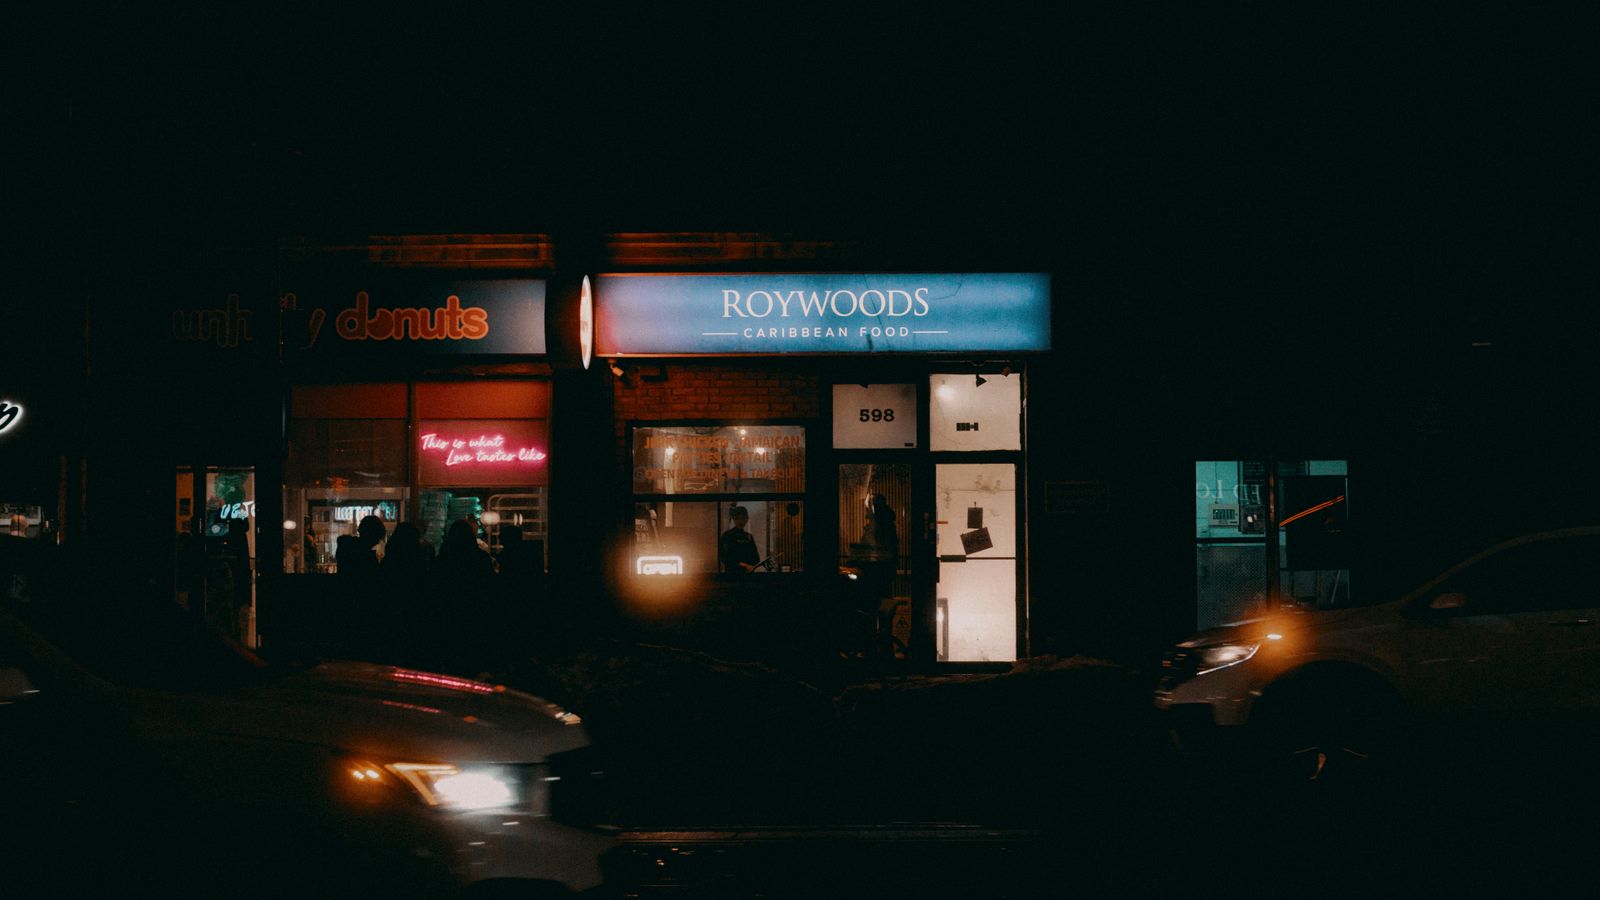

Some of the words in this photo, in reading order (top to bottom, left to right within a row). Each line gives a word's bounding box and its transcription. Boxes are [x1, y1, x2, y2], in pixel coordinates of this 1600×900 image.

[722, 288, 929, 318] ROYWOODS
[335, 291, 489, 340] donuts
[744, 327, 848, 338] CARIBBEAN
[860, 326, 909, 338] FOOD
[859, 408, 895, 423] 598
[421, 433, 449, 450] This
[452, 439, 467, 449] is
[469, 435, 504, 448] what
[737, 436, 800, 449] JAMAICAN
[445, 449, 475, 466] Love
[476, 449, 517, 462] tastes
[518, 447, 547, 461] like
